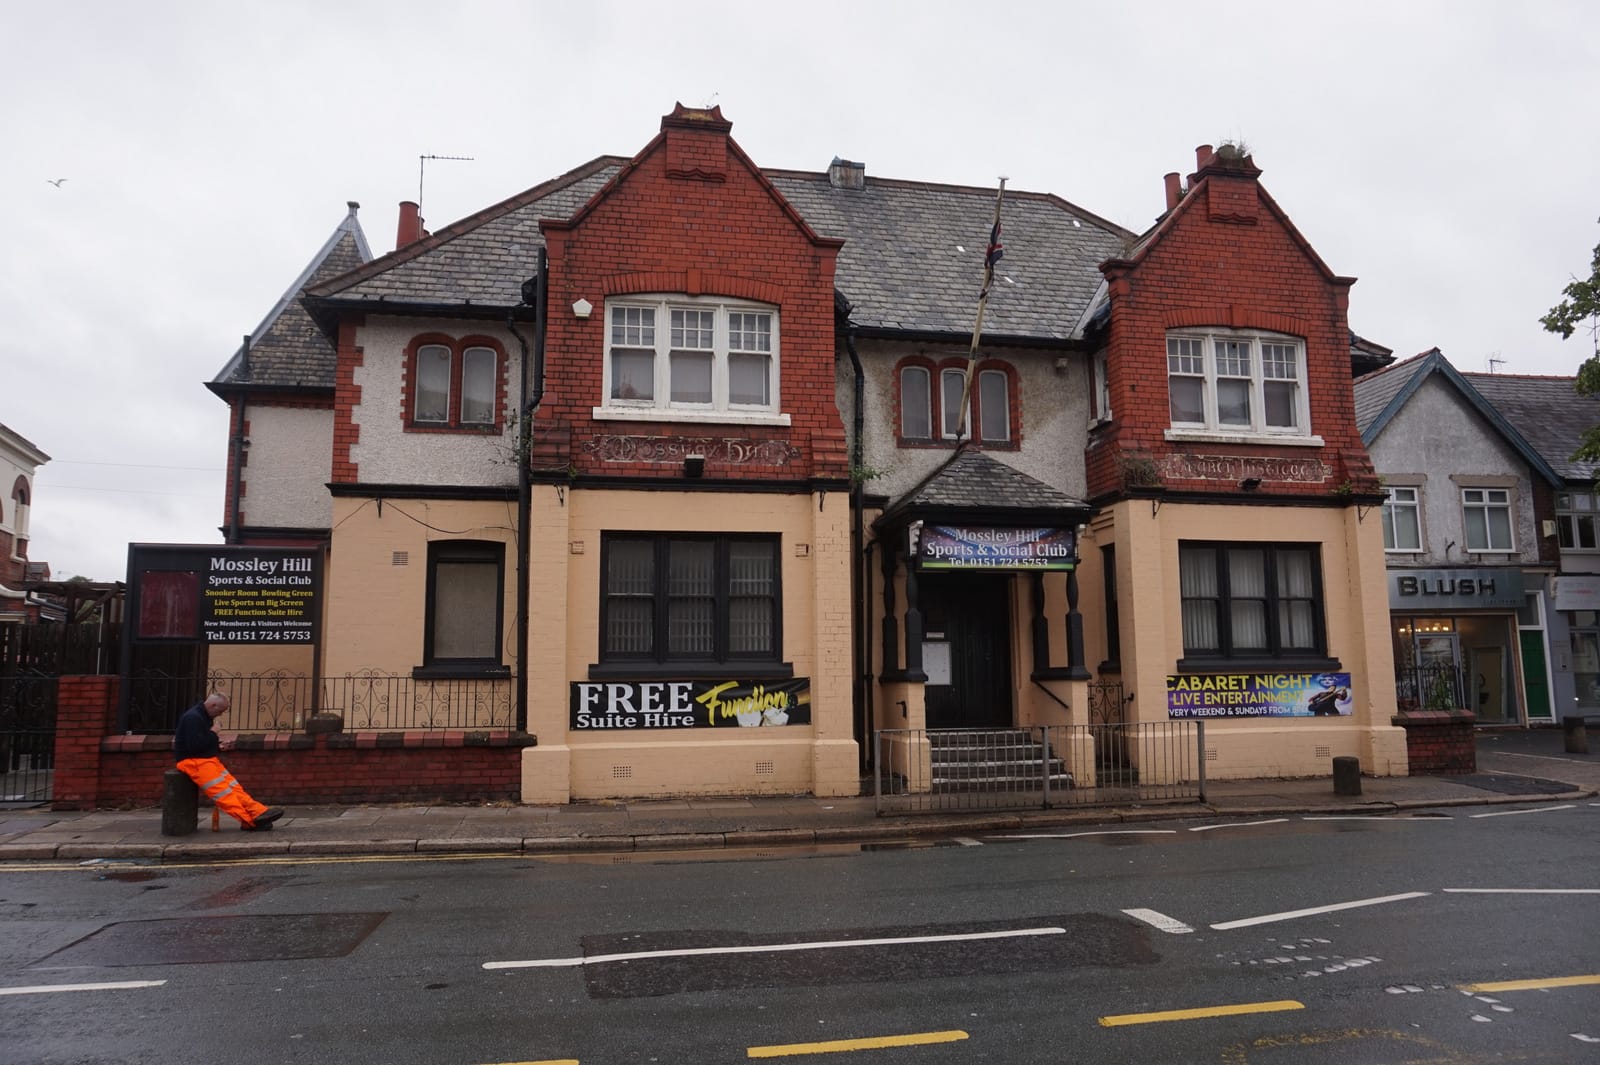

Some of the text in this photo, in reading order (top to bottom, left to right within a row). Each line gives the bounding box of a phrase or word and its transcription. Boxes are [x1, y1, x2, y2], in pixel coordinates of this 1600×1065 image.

[955, 529, 1040, 544] Mossley Hill
[927, 543, 1067, 558] Sports & Social Club
[210, 557, 311, 574] Mossley Hill
[970, 558, 996, 567] 0151
[1000, 558, 1020, 567] 724
[1023, 558, 1048, 567] 5753
[209, 576, 311, 586] Sports & Social Club
[261, 590, 290, 598] Bowling
[206, 631, 311, 640] Tel. 0151 724 5753
[1167, 674, 1312, 691] CABARET NIGHT
[577, 682, 693, 714] FREE
[695, 680, 788, 726] Function
[1173, 691, 1304, 706] LIVE ENTERTAINMENT
[1168, 708, 1189, 717] VERY
[1191, 708, 1226, 716] WEEKEND
[1235, 707, 1267, 715] SUNDAYS
[1268, 706, 1291, 714] FROM
[576, 713, 695, 728] Suite Hire
